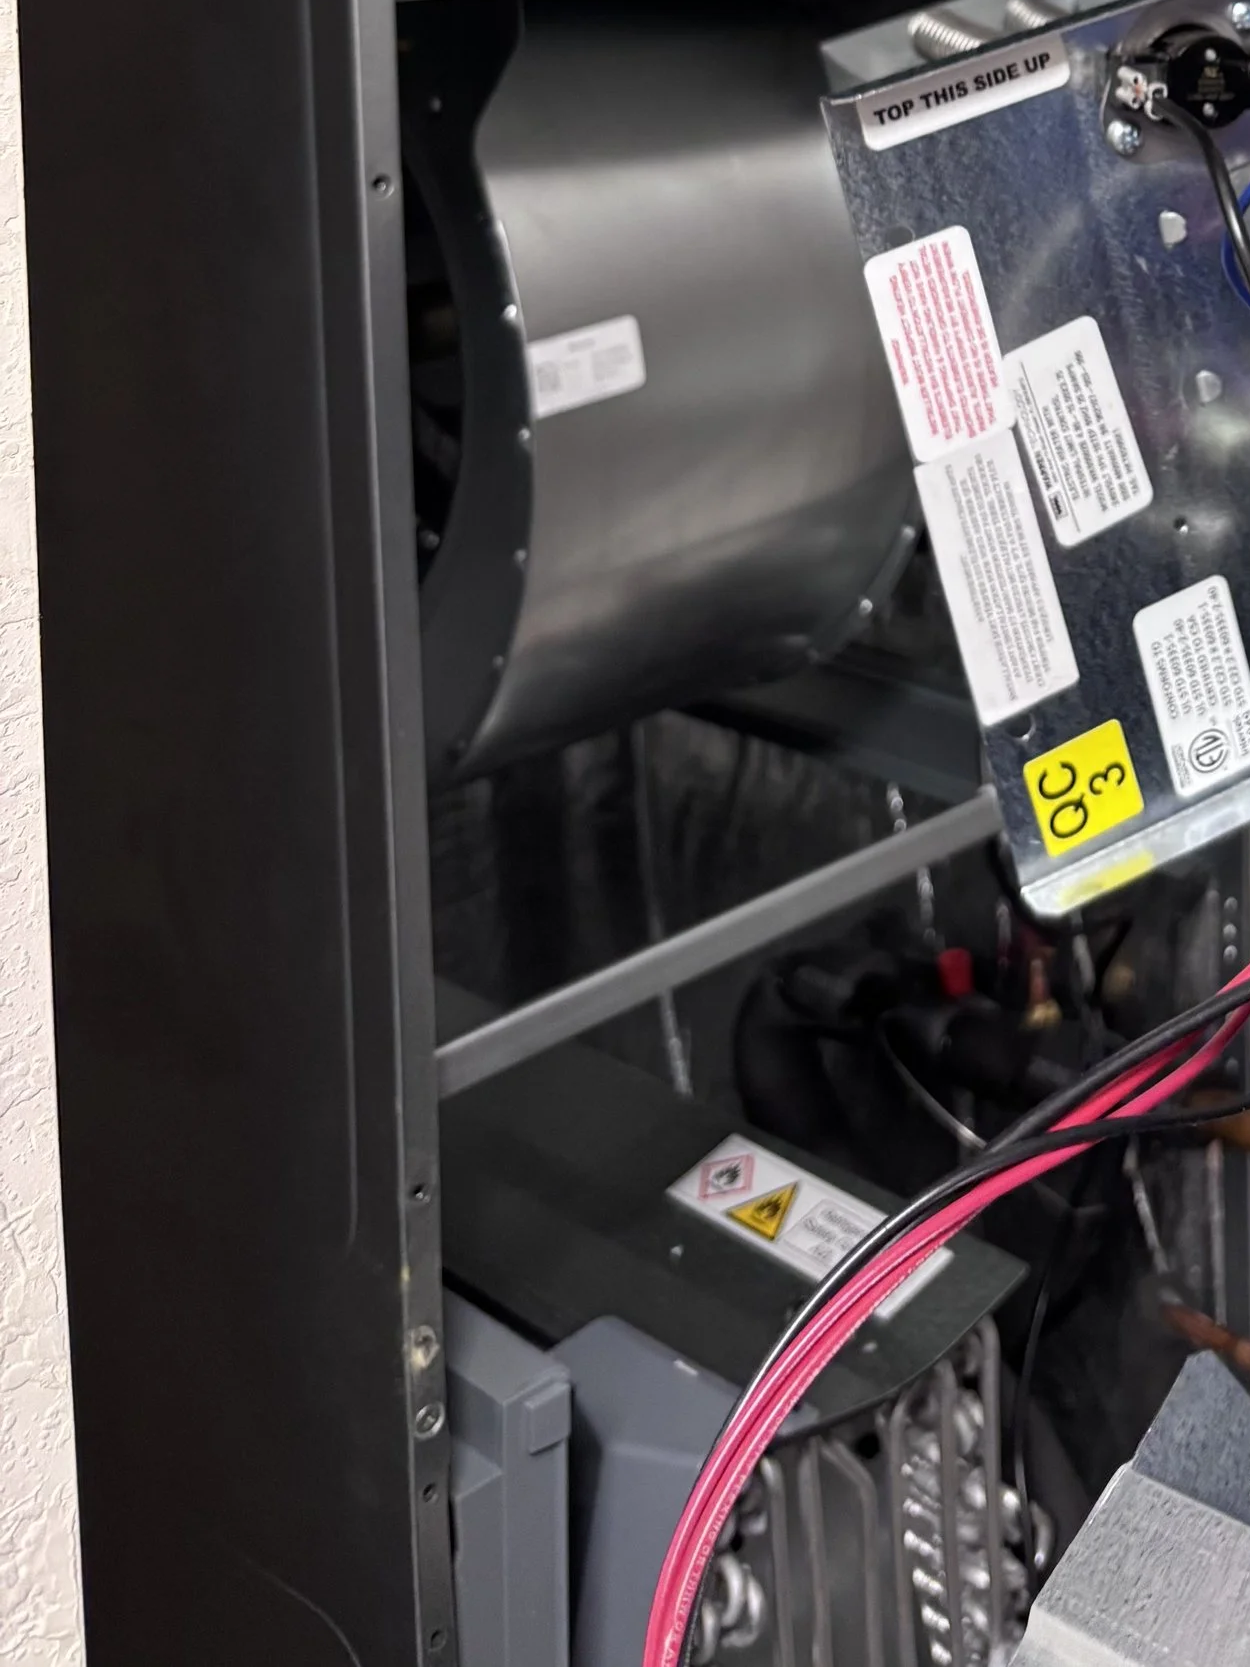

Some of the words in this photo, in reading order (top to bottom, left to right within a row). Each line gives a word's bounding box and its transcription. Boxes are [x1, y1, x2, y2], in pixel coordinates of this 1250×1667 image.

[873, 98, 914, 124] TOP
[919, 80, 968, 108] THIS
[973, 63, 1018, 90] SIDE
[1023, 52, 1050, 72] UP
[1038, 761, 1089, 839] QC
[1088, 762, 1126, 796] 3
